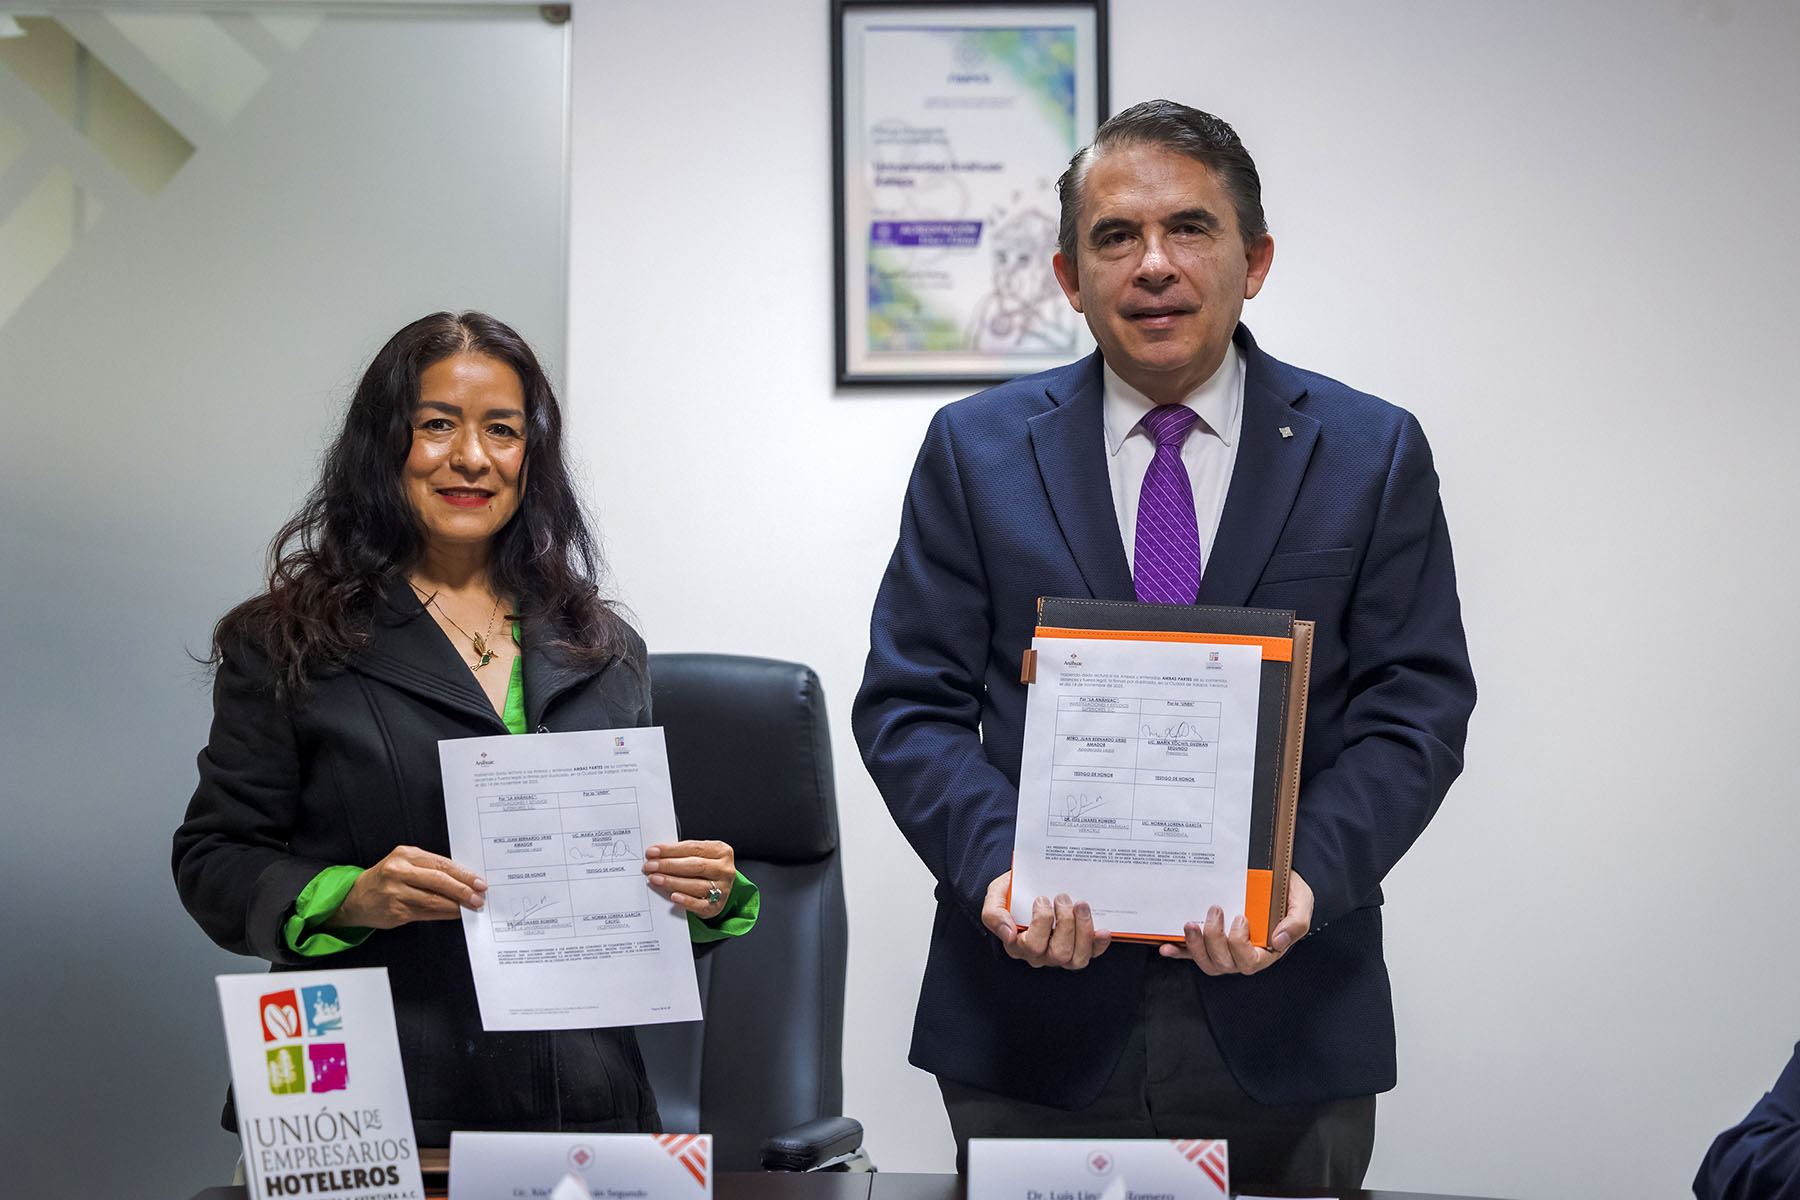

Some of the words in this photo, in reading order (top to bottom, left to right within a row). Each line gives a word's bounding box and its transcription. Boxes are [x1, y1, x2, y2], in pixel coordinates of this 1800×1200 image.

[254, 1106, 362, 1148] UNIÓN
[262, 1138, 410, 1172] EMPRESARIOS
[265, 1166, 400, 1197] HOTELEROS
